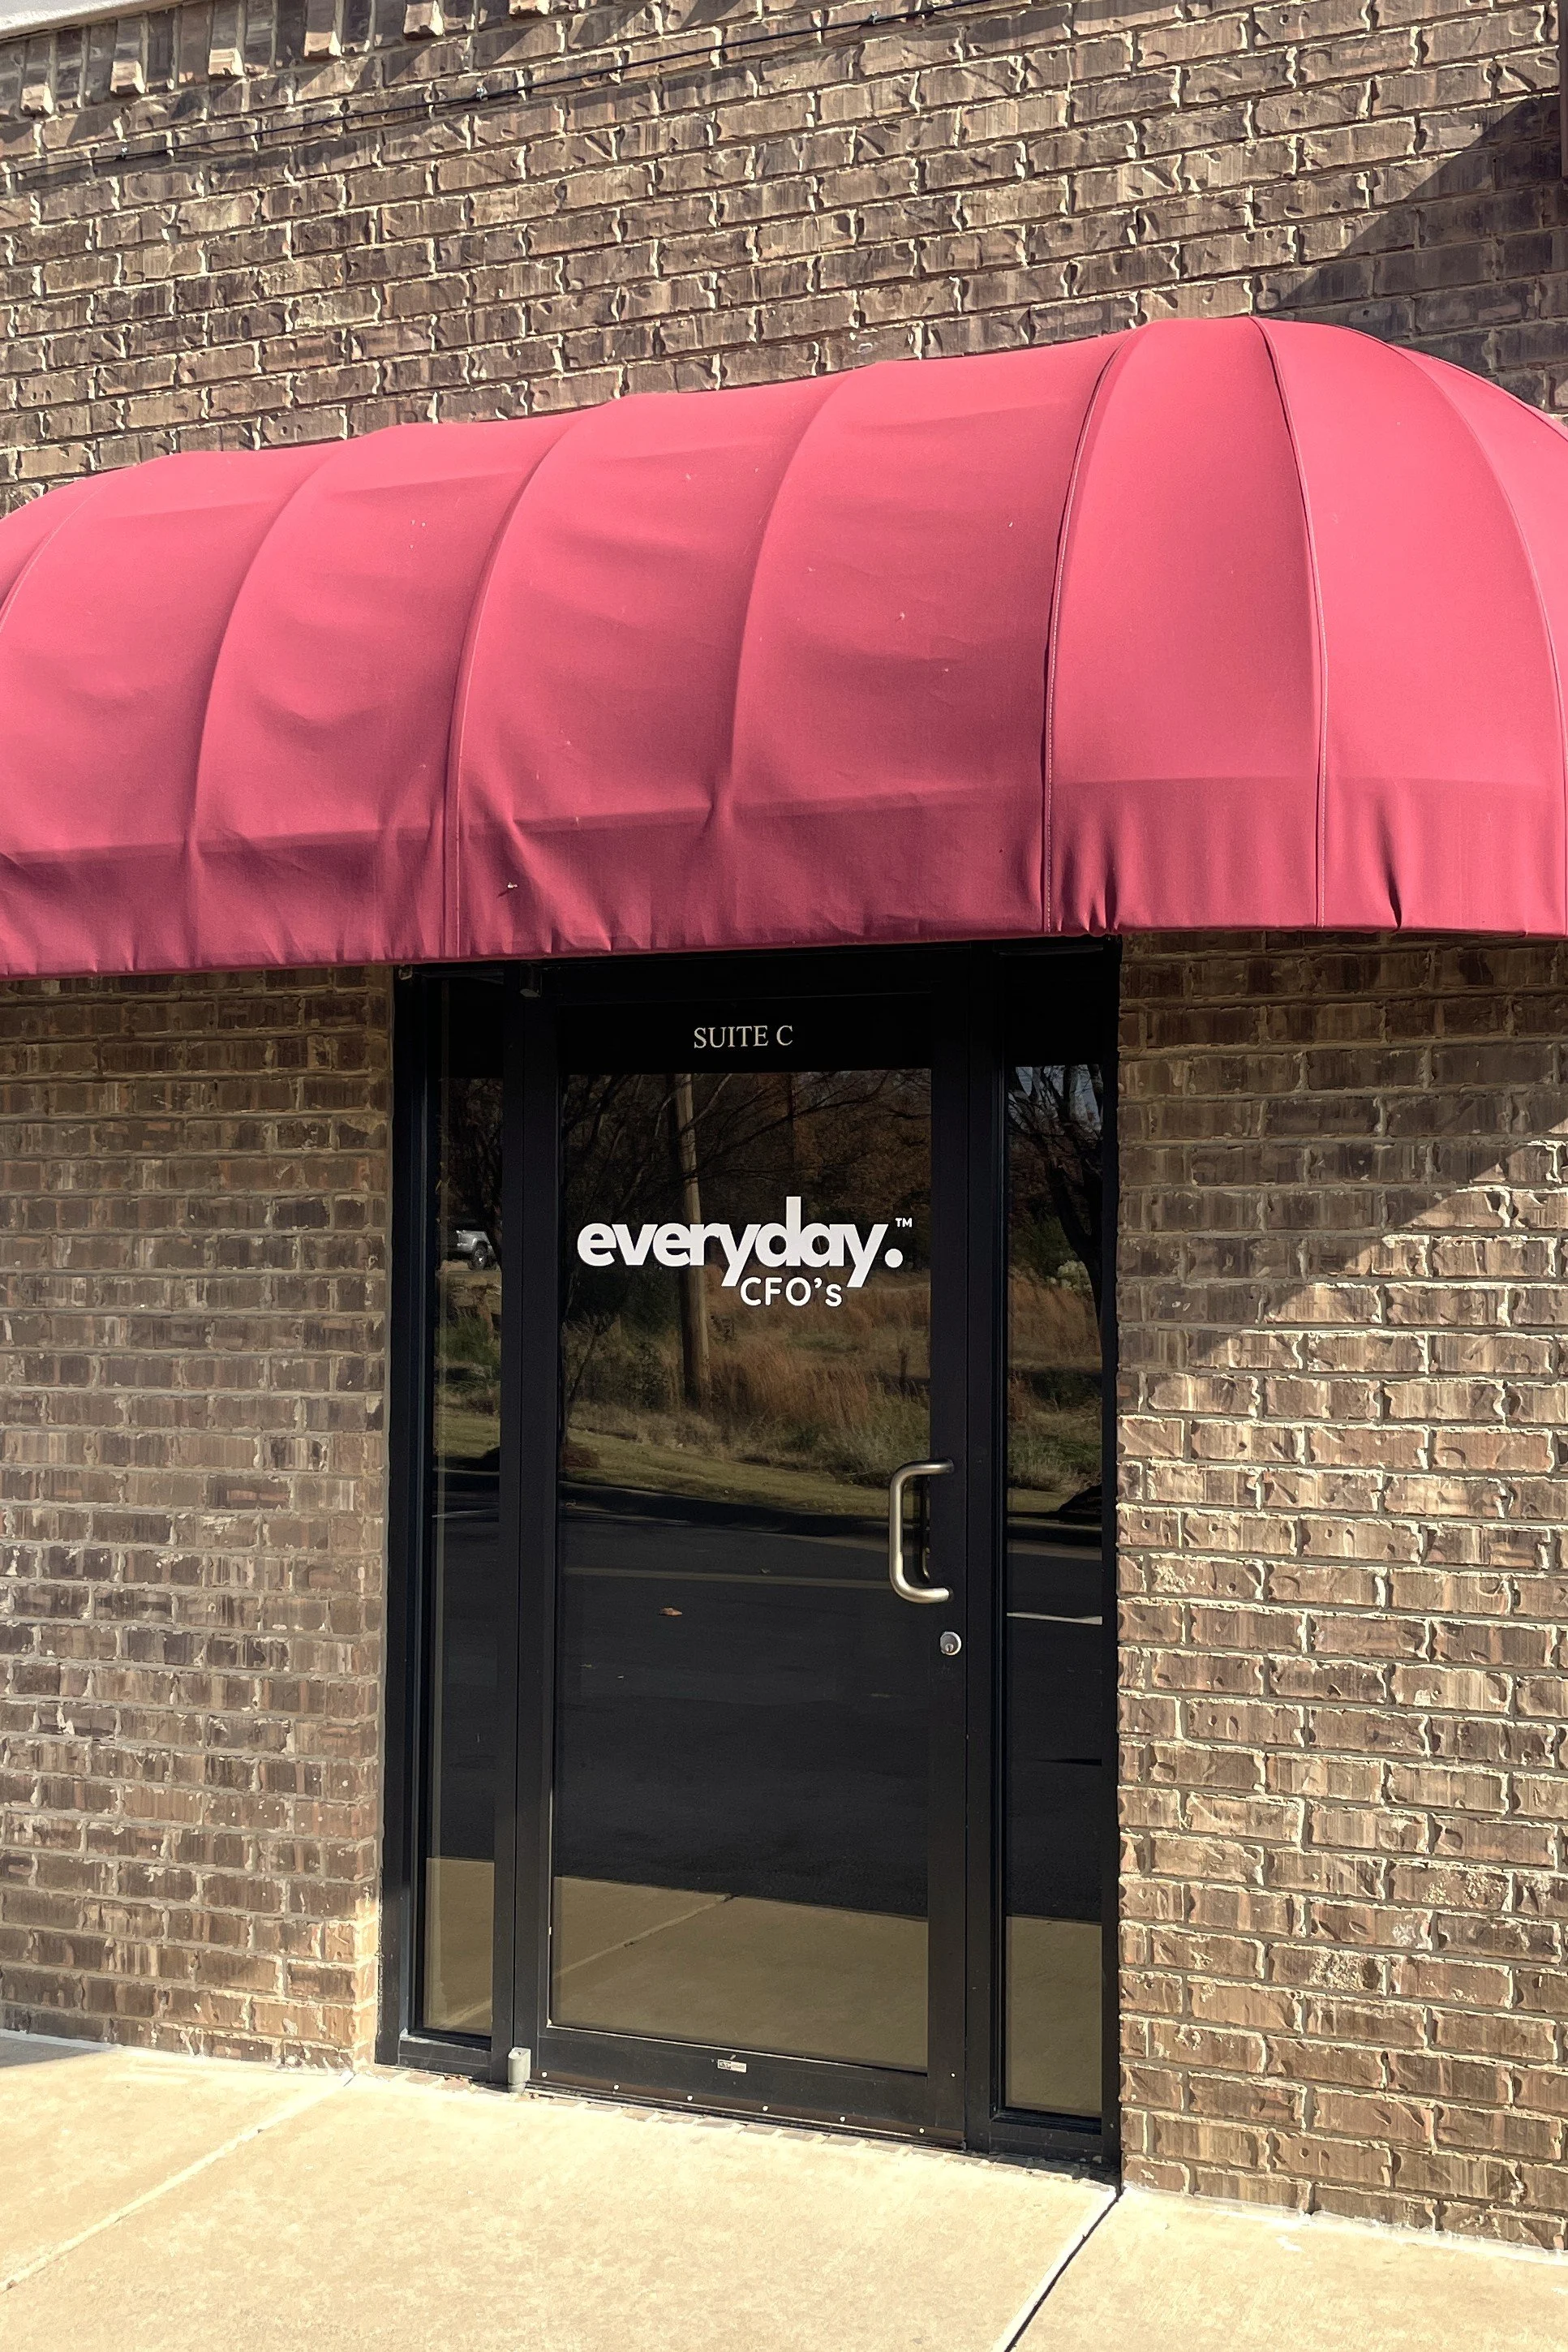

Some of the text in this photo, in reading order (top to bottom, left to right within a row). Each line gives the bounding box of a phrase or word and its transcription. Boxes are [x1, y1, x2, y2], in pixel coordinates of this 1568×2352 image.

[694, 1025, 793, 1049] SUITE C
[577, 1196, 904, 1288] everyday.
[740, 1276, 842, 1307] CFO's
